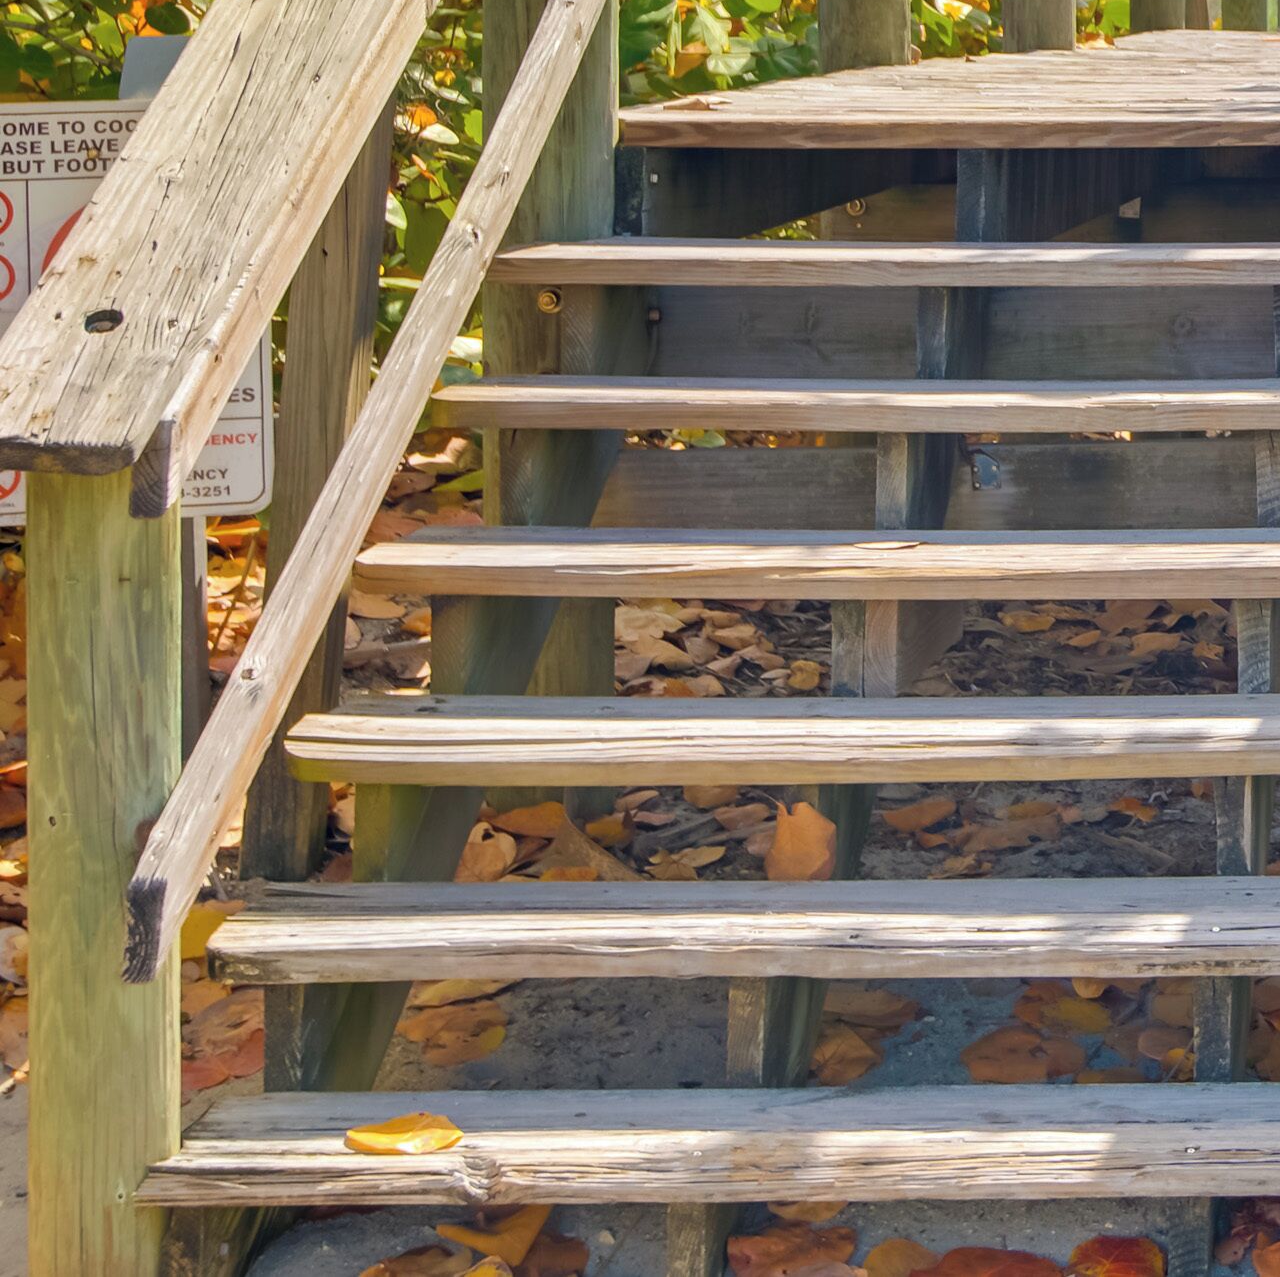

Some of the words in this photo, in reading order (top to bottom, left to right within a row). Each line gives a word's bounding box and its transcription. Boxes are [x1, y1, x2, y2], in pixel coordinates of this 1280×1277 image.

[0, 122, 49, 136] OME
[57, 121, 85, 135] TO
[51, 139, 119, 153] LEAVE
[2, 159, 46, 175] BUT
[55, 157, 116, 173] FOOT
[205, 434, 257, 446] ENCY
